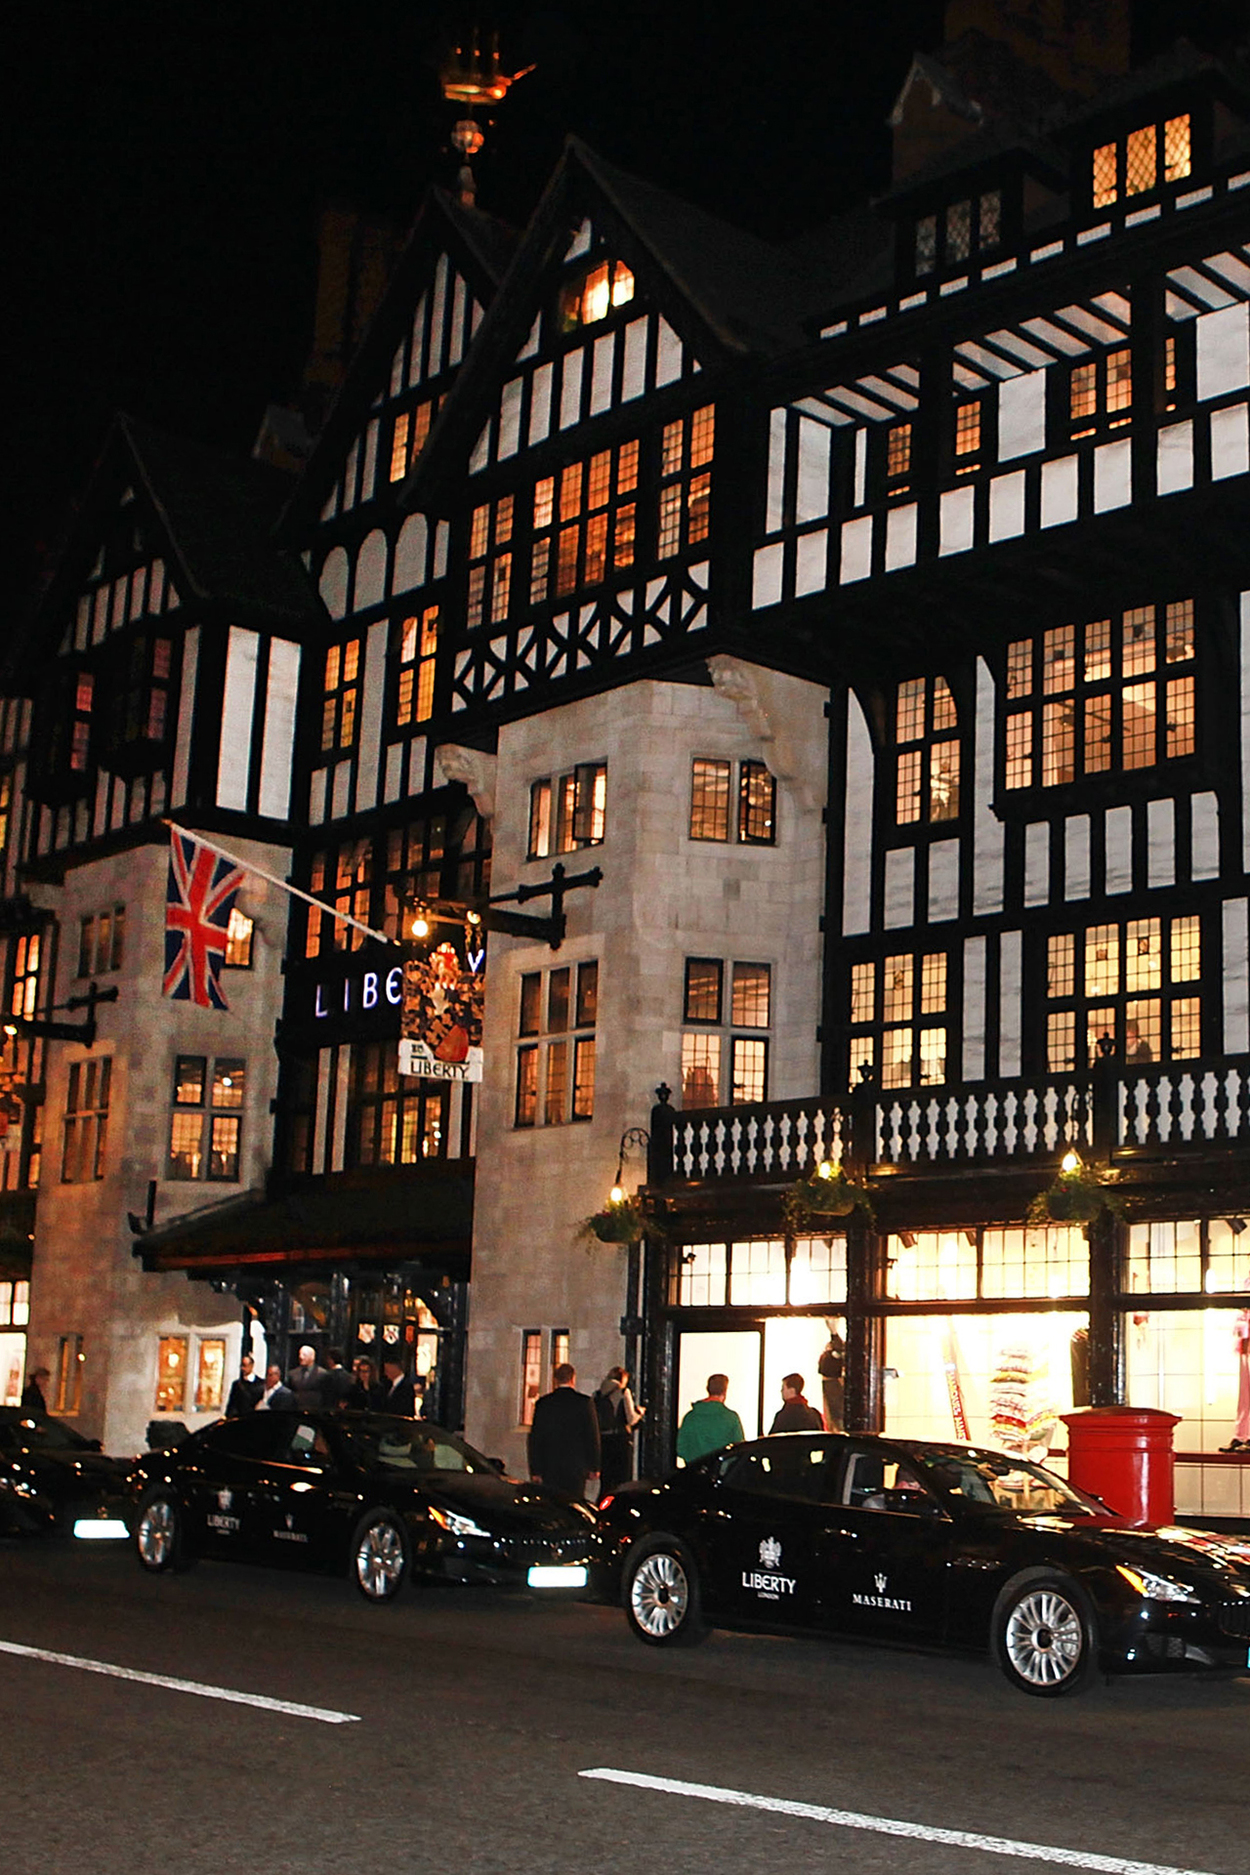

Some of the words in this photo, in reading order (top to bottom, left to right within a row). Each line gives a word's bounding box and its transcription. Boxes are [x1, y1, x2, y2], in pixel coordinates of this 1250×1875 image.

[315, 949, 485, 1018] LIBEY
[410, 1061, 469, 1079] LIBERTY
[206, 1513, 241, 1530] LIBERTY
[741, 1571, 797, 1594] LIBERTY
[852, 1593, 912, 1612] MASERATI
